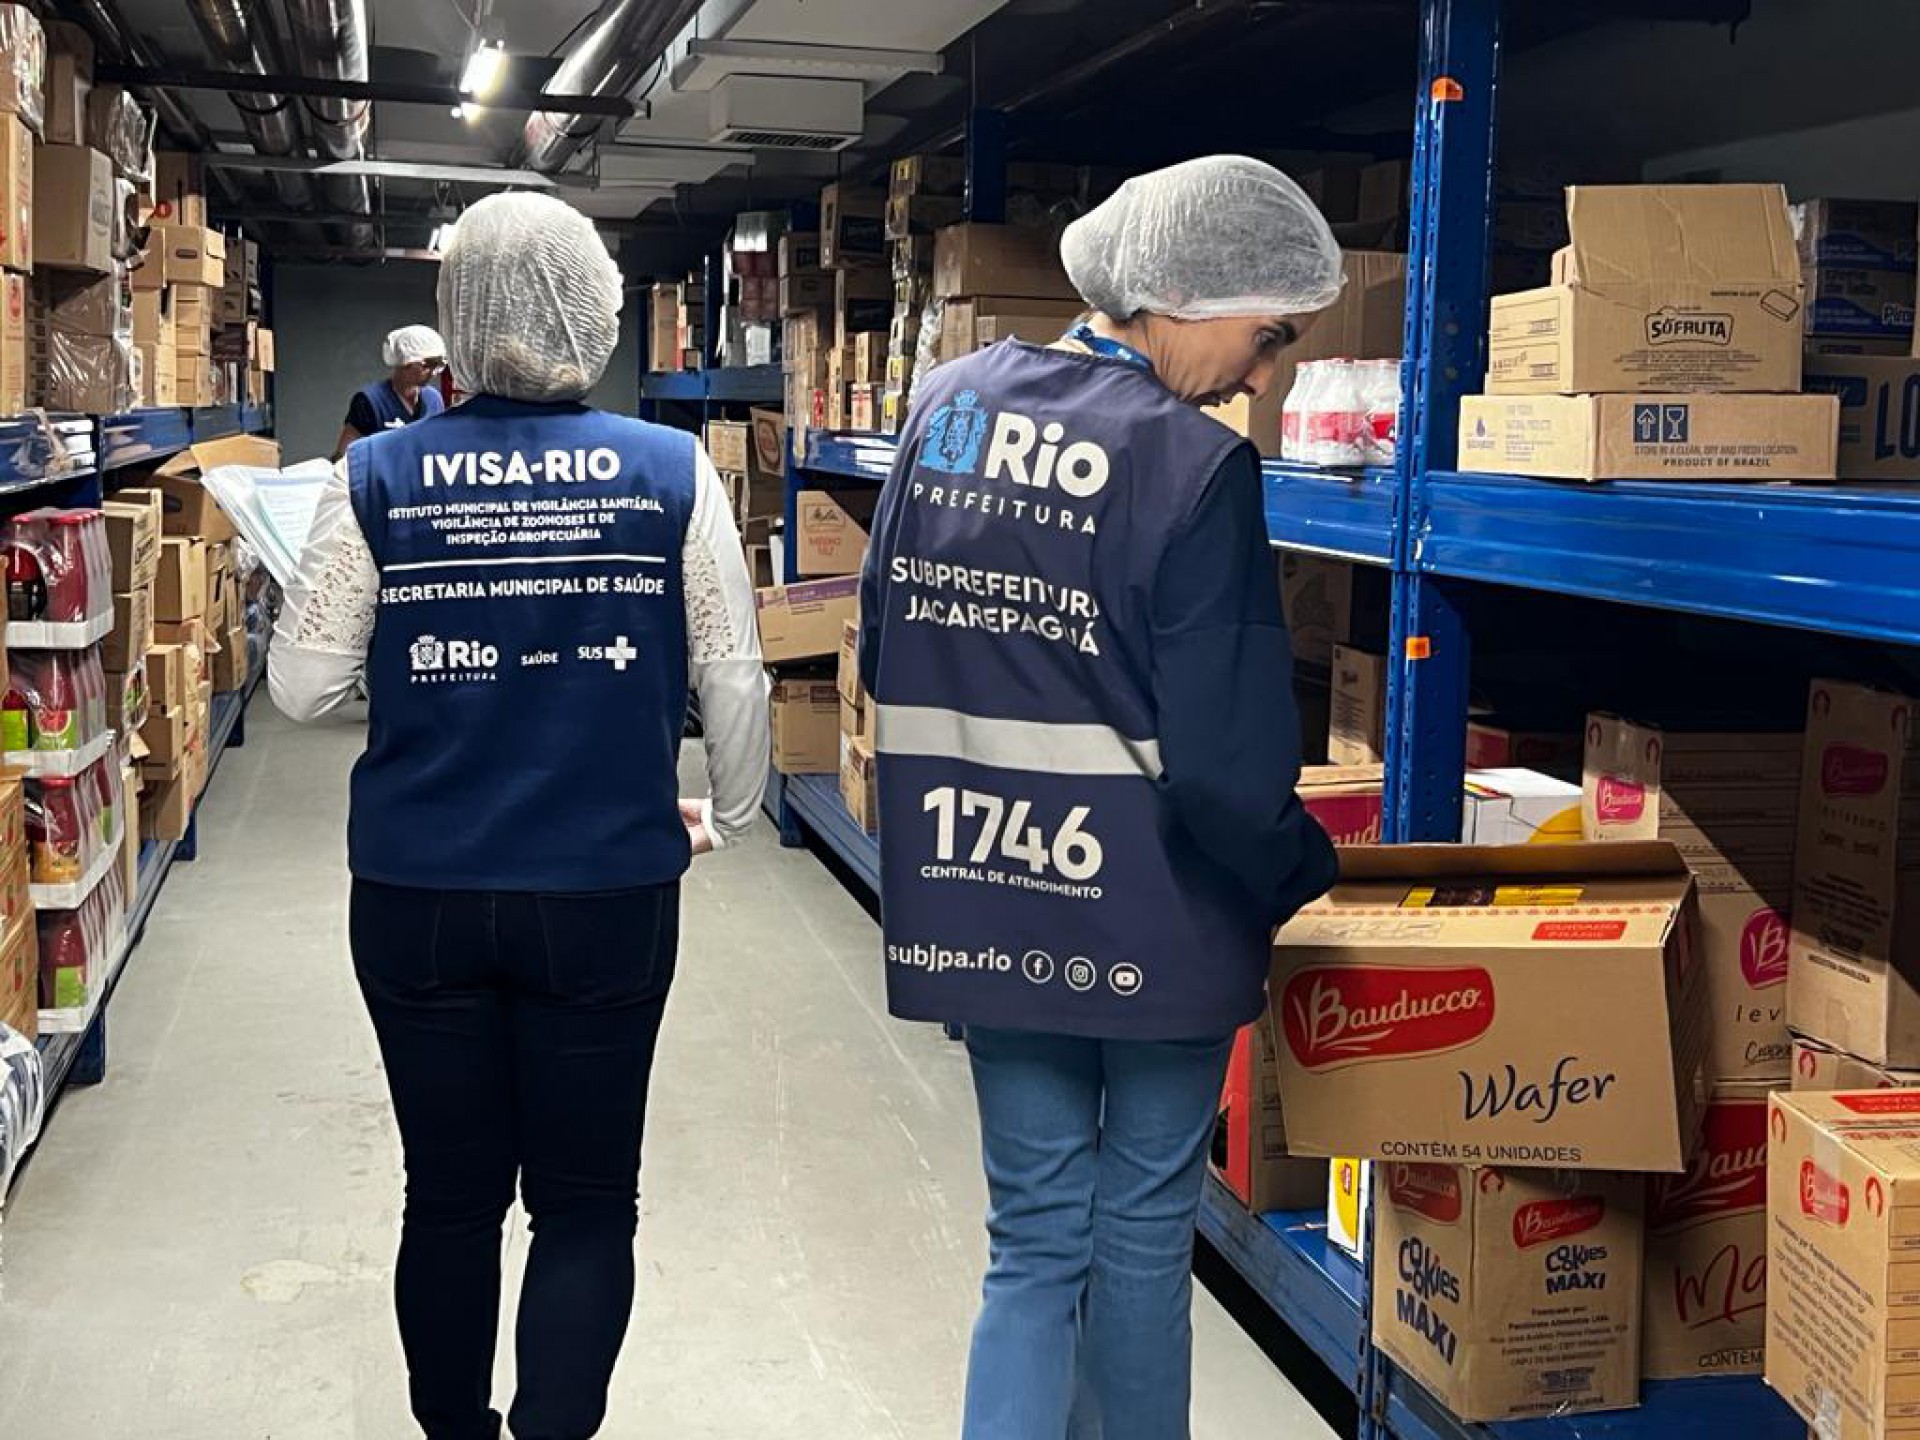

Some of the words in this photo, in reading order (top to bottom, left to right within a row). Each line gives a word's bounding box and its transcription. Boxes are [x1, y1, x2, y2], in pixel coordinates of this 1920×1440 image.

[422, 447, 621, 487] IVISA-RIO
[984, 411, 1109, 497] Rio
[446, 502, 511, 515] MUNICIPAL
[512, 500, 529, 513] DE
[503, 515, 519, 528] DE
[521, 513, 586, 528] ZOONOSES
[588, 512, 597, 524] E
[599, 511, 616, 524] DE
[913, 483, 1096, 535] PREFEITURA
[381, 582, 487, 604] SECRETARIA
[489, 577, 584, 598] MUNICIPAL
[586, 576, 609, 594] DE
[613, 573, 666, 596] SAÚDE
[448, 640, 499, 669] Rio
[521, 651, 560, 666] SAÚDE
[577, 646, 604, 660] SUS
[923, 786, 1103, 881] 1746
[920, 865, 985, 882] CENTRAL
[987, 871, 1006, 885] DE
[1008, 875, 1103, 900] ATENDIMENTO
[888, 943, 1012, 973] subjpa.rio
[1295, 974, 1482, 1051] Bauducco
[1458, 1055, 1617, 1124] Wafer
[1461, 1145, 1482, 1160] 54
[1486, 1145, 1583, 1163] UNIDADES
[1545, 1272, 1607, 1295] MAXI
[1396, 1287, 1457, 1366] MAXI
